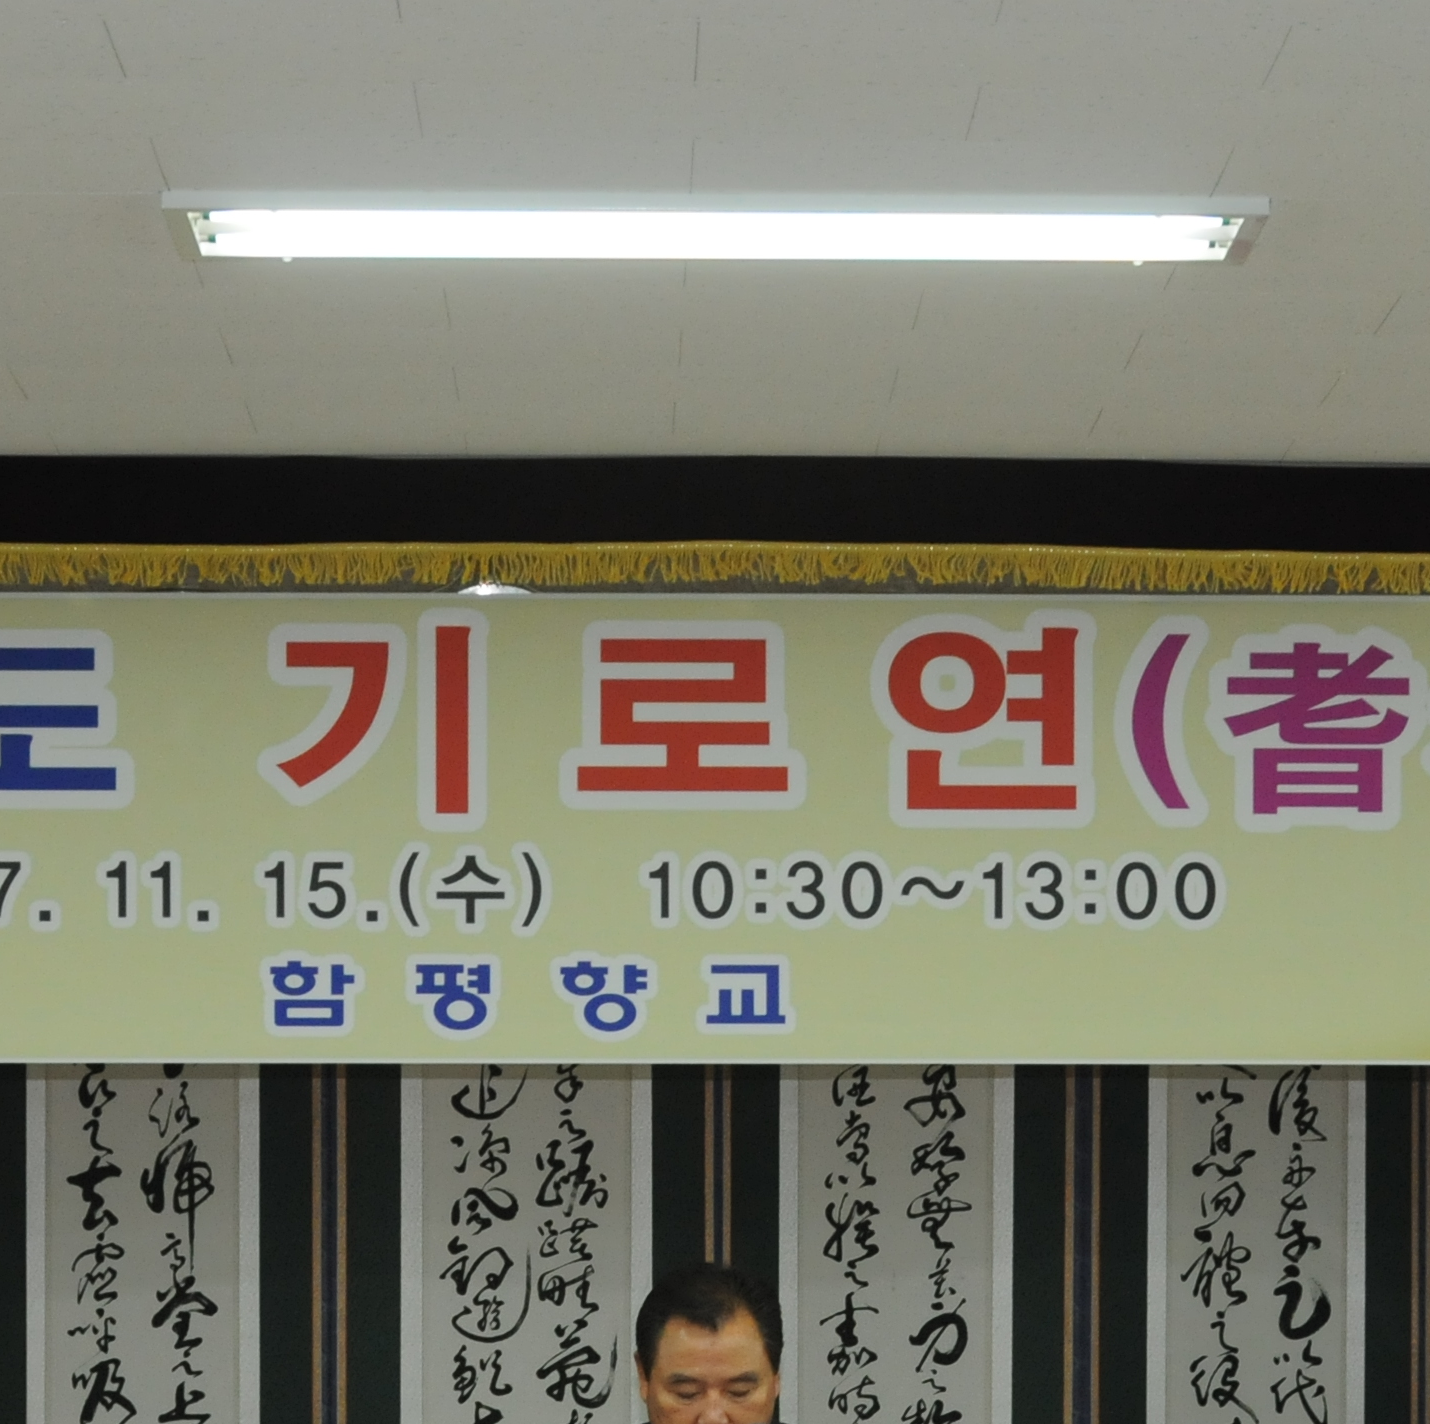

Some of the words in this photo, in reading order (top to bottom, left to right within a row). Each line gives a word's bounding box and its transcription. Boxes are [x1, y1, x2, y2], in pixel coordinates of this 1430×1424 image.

[105, 860, 211, 922] 11.
[263, 851, 543, 927] 15.(수)
[648, 860, 1218, 921] 10:30~13:00
[269, 960, 787, 1033] 함평향교
